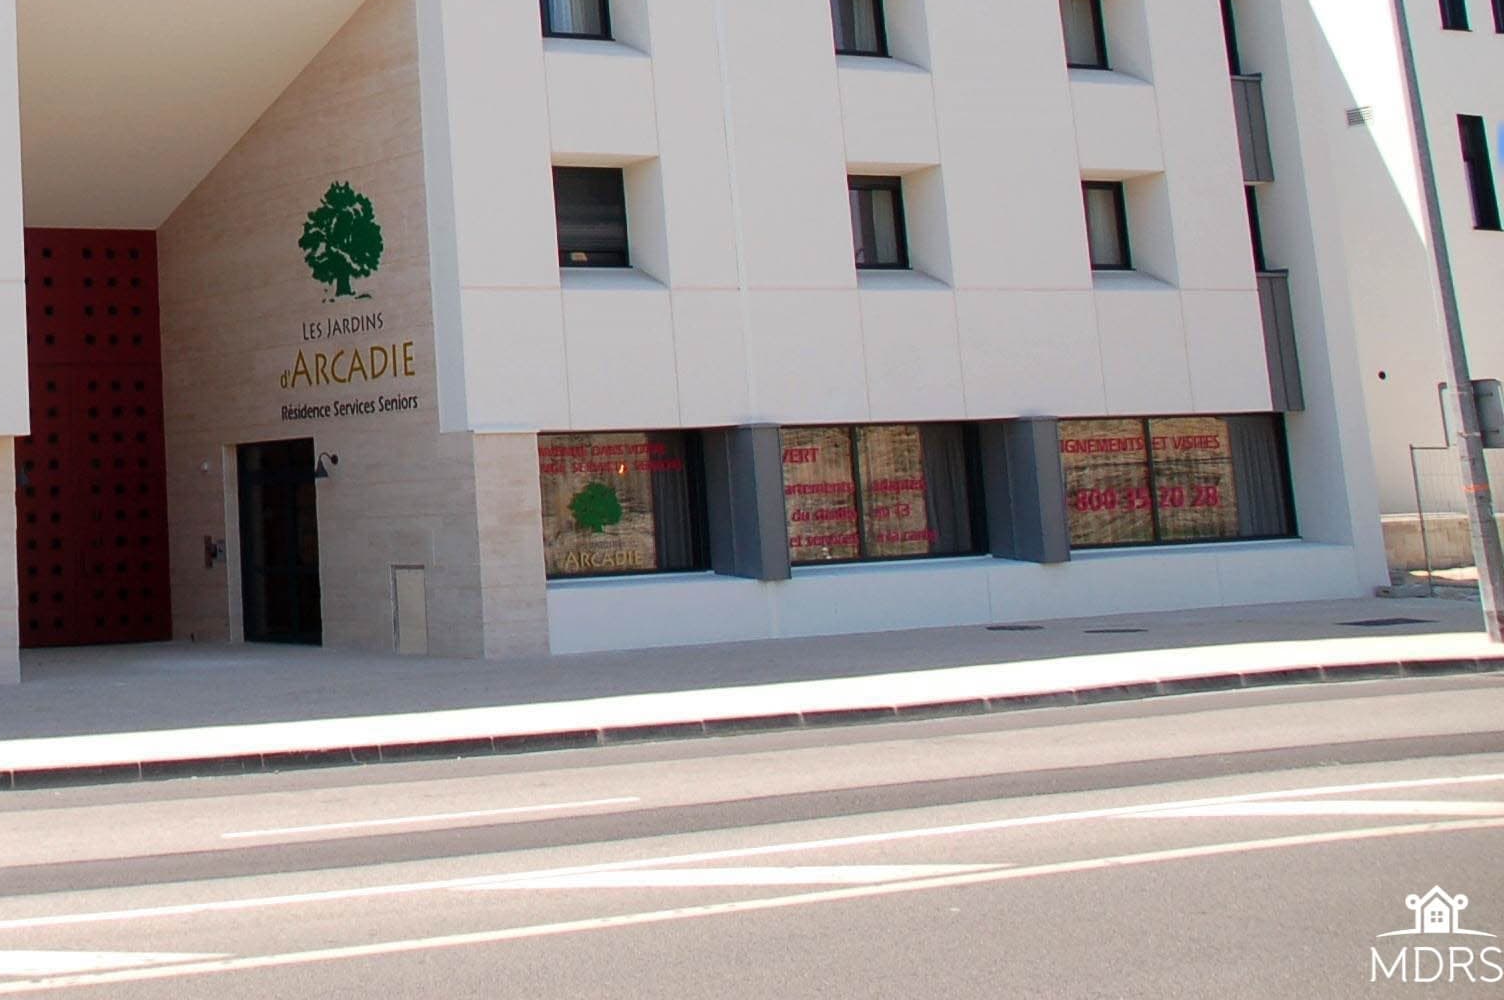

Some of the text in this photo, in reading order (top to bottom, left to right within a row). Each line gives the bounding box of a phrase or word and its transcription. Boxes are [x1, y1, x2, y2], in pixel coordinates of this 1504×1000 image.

[302, 312, 384, 341] LES JARDINS
[280, 341, 416, 389] d'ARCADIE
[281, 394, 418, 421] Résidence Services Seniors
[1152, 436, 1168, 450] ET
